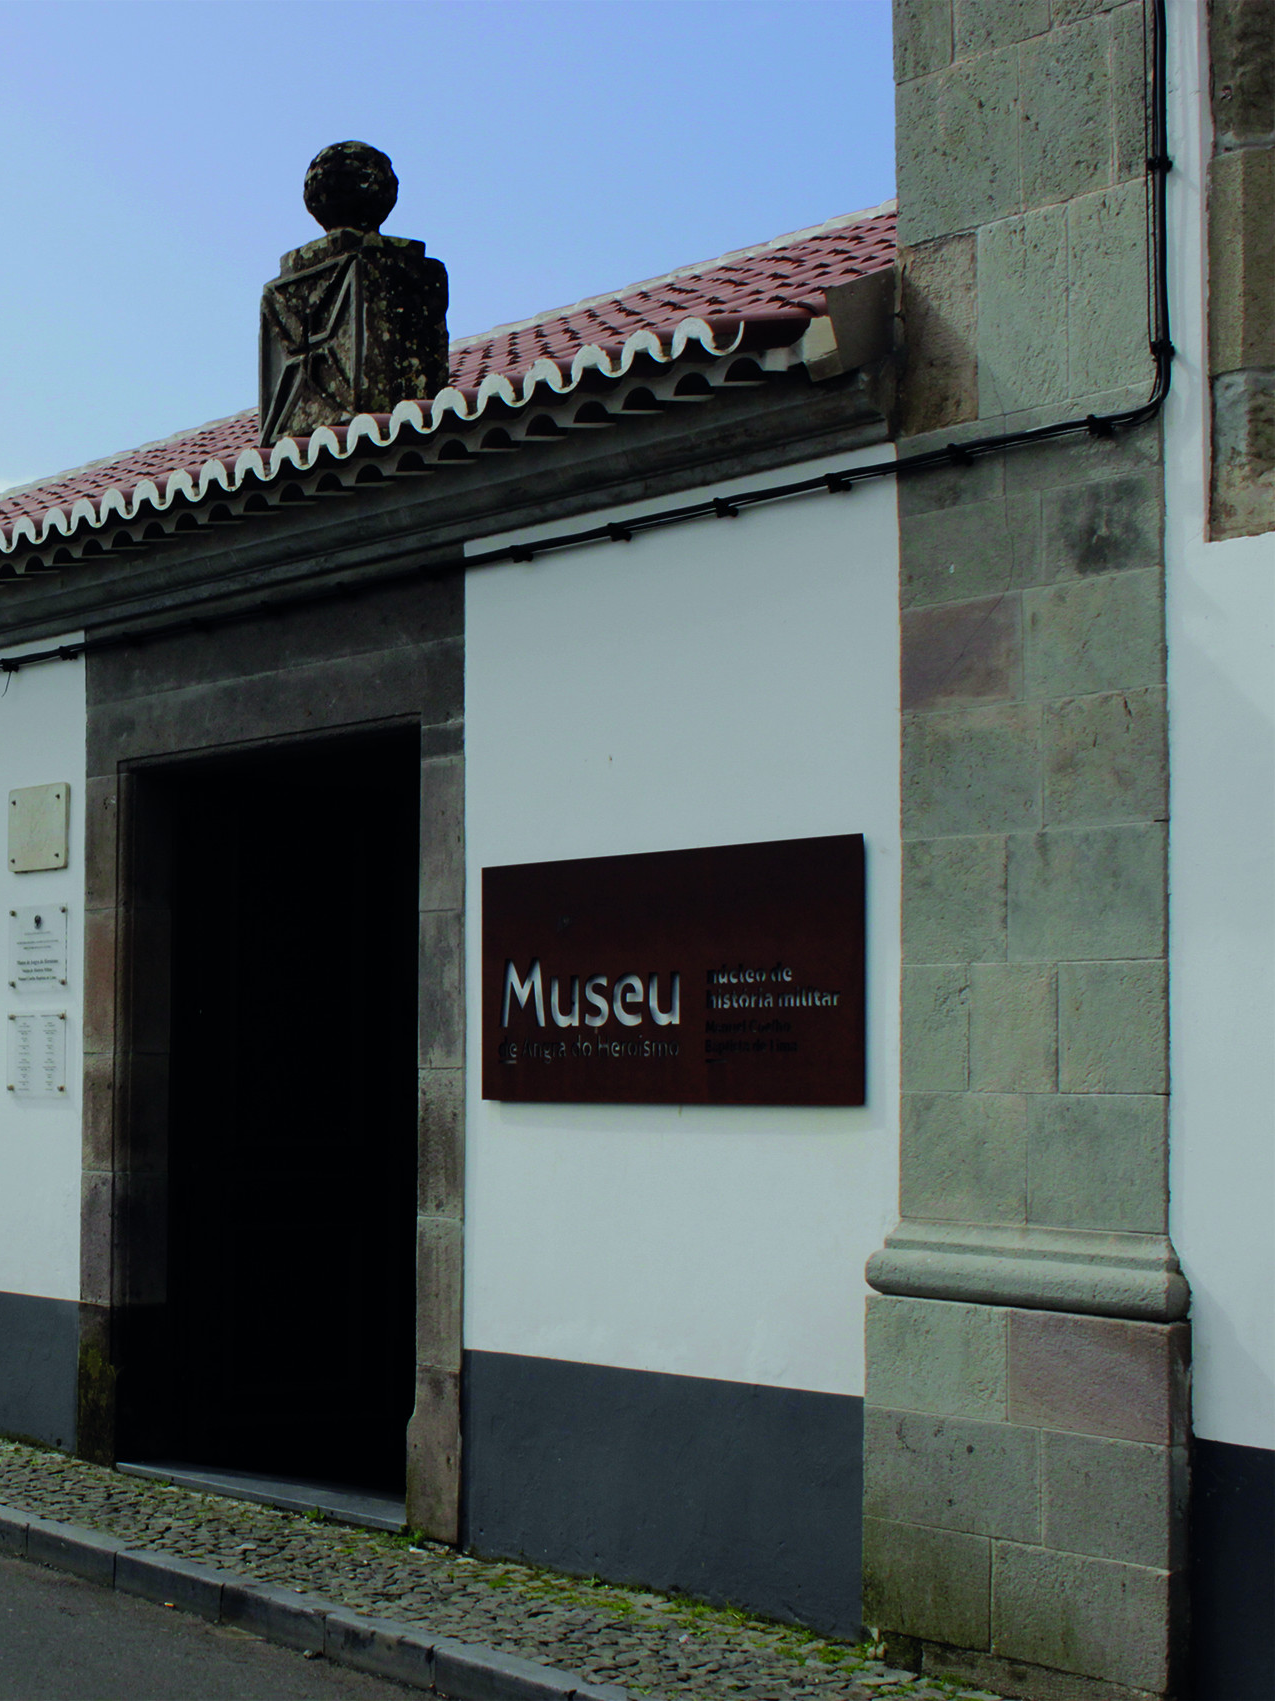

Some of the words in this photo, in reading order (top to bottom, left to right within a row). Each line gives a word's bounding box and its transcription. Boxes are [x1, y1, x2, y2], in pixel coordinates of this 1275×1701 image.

[707, 963, 766, 984] núcleo
[770, 961, 793, 982] de
[501, 957, 681, 1028] Museu
[707, 986, 774, 1009] história
[778, 985, 841, 1007] militar
[499, 1036, 518, 1059] de
[522, 1036, 567, 1064] Angra
[571, 1034, 593, 1058] do
